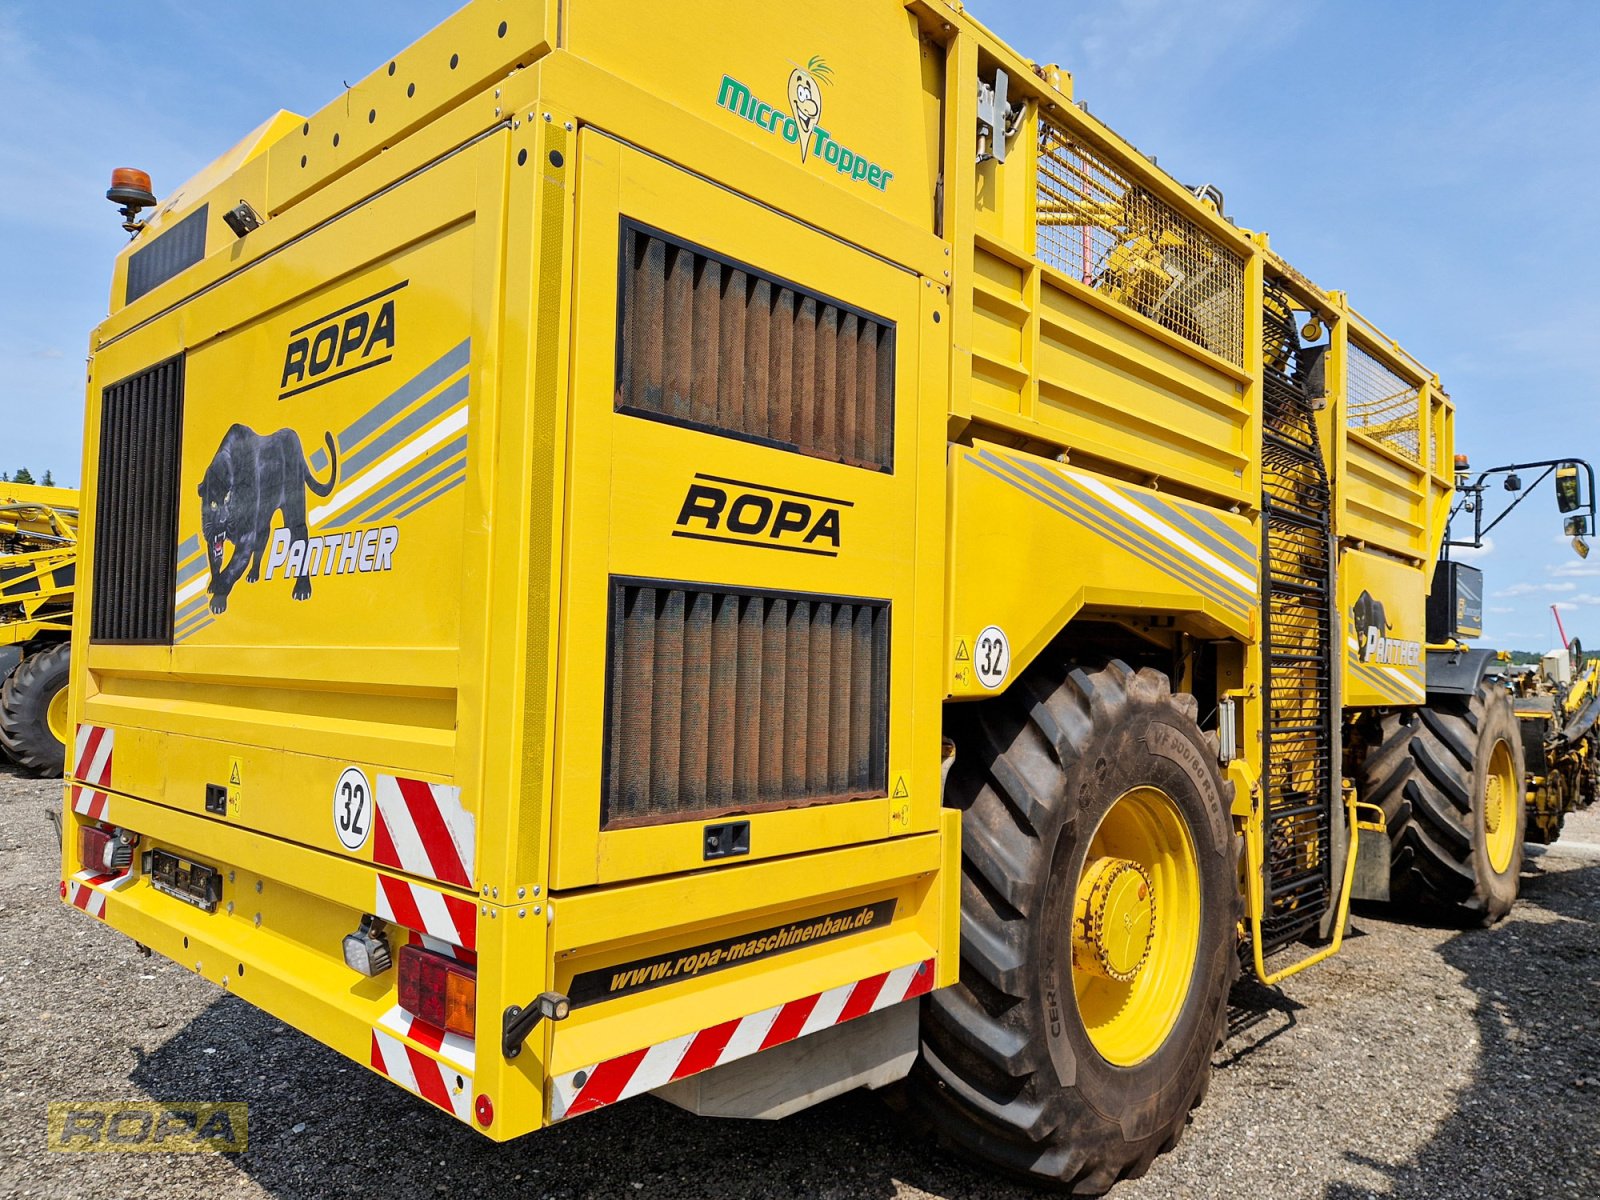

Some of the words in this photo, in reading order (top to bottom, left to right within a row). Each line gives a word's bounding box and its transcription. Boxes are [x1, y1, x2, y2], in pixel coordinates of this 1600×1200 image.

[716, 73, 800, 145] Micro
[812, 124, 894, 192] Topper
[280, 299, 396, 389] ROPA
[676, 483, 841, 548] ROPA
[264, 524, 400, 581] PANTHER
[981, 637, 1003, 676] 32
[340, 781, 365, 836] 32
[608, 907, 875, 992] www.ropa-maschinenbau.de
